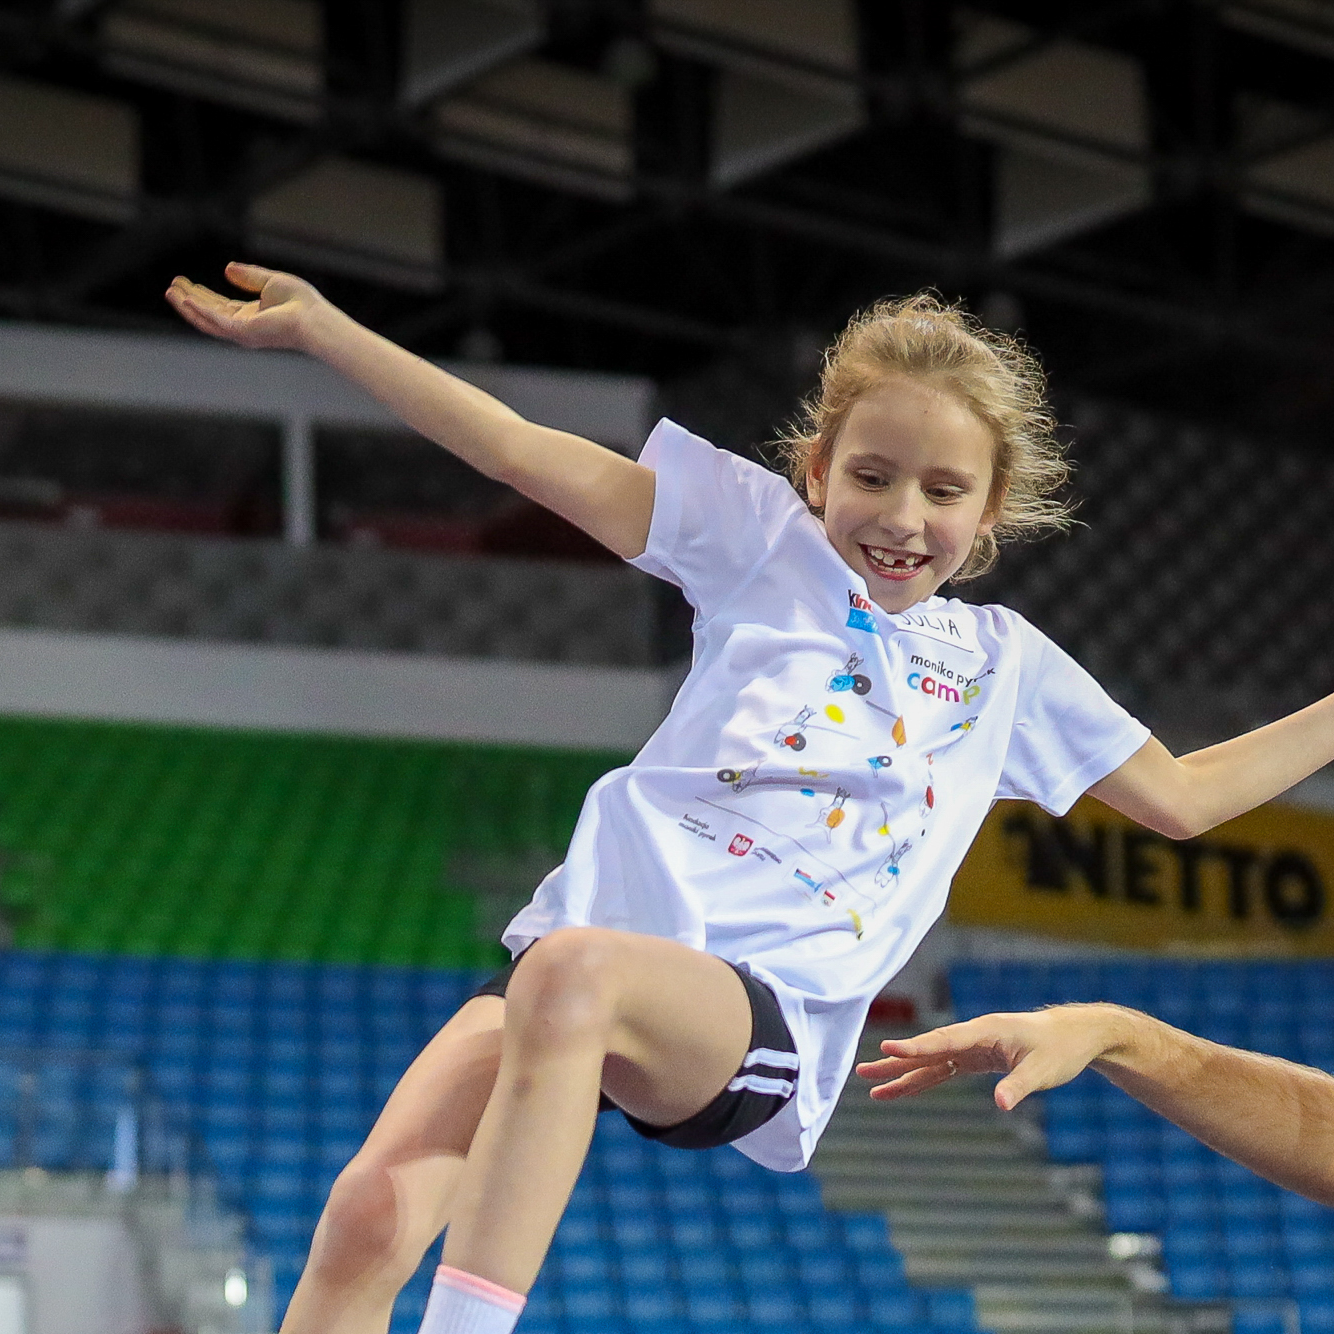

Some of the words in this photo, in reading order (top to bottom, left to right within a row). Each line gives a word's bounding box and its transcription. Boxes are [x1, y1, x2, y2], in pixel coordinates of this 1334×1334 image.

[897, 613, 962, 639] JULIA
[910, 654, 954, 680] monika
[906, 672, 981, 706] camp
[1023, 814, 1327, 928] NETTO
